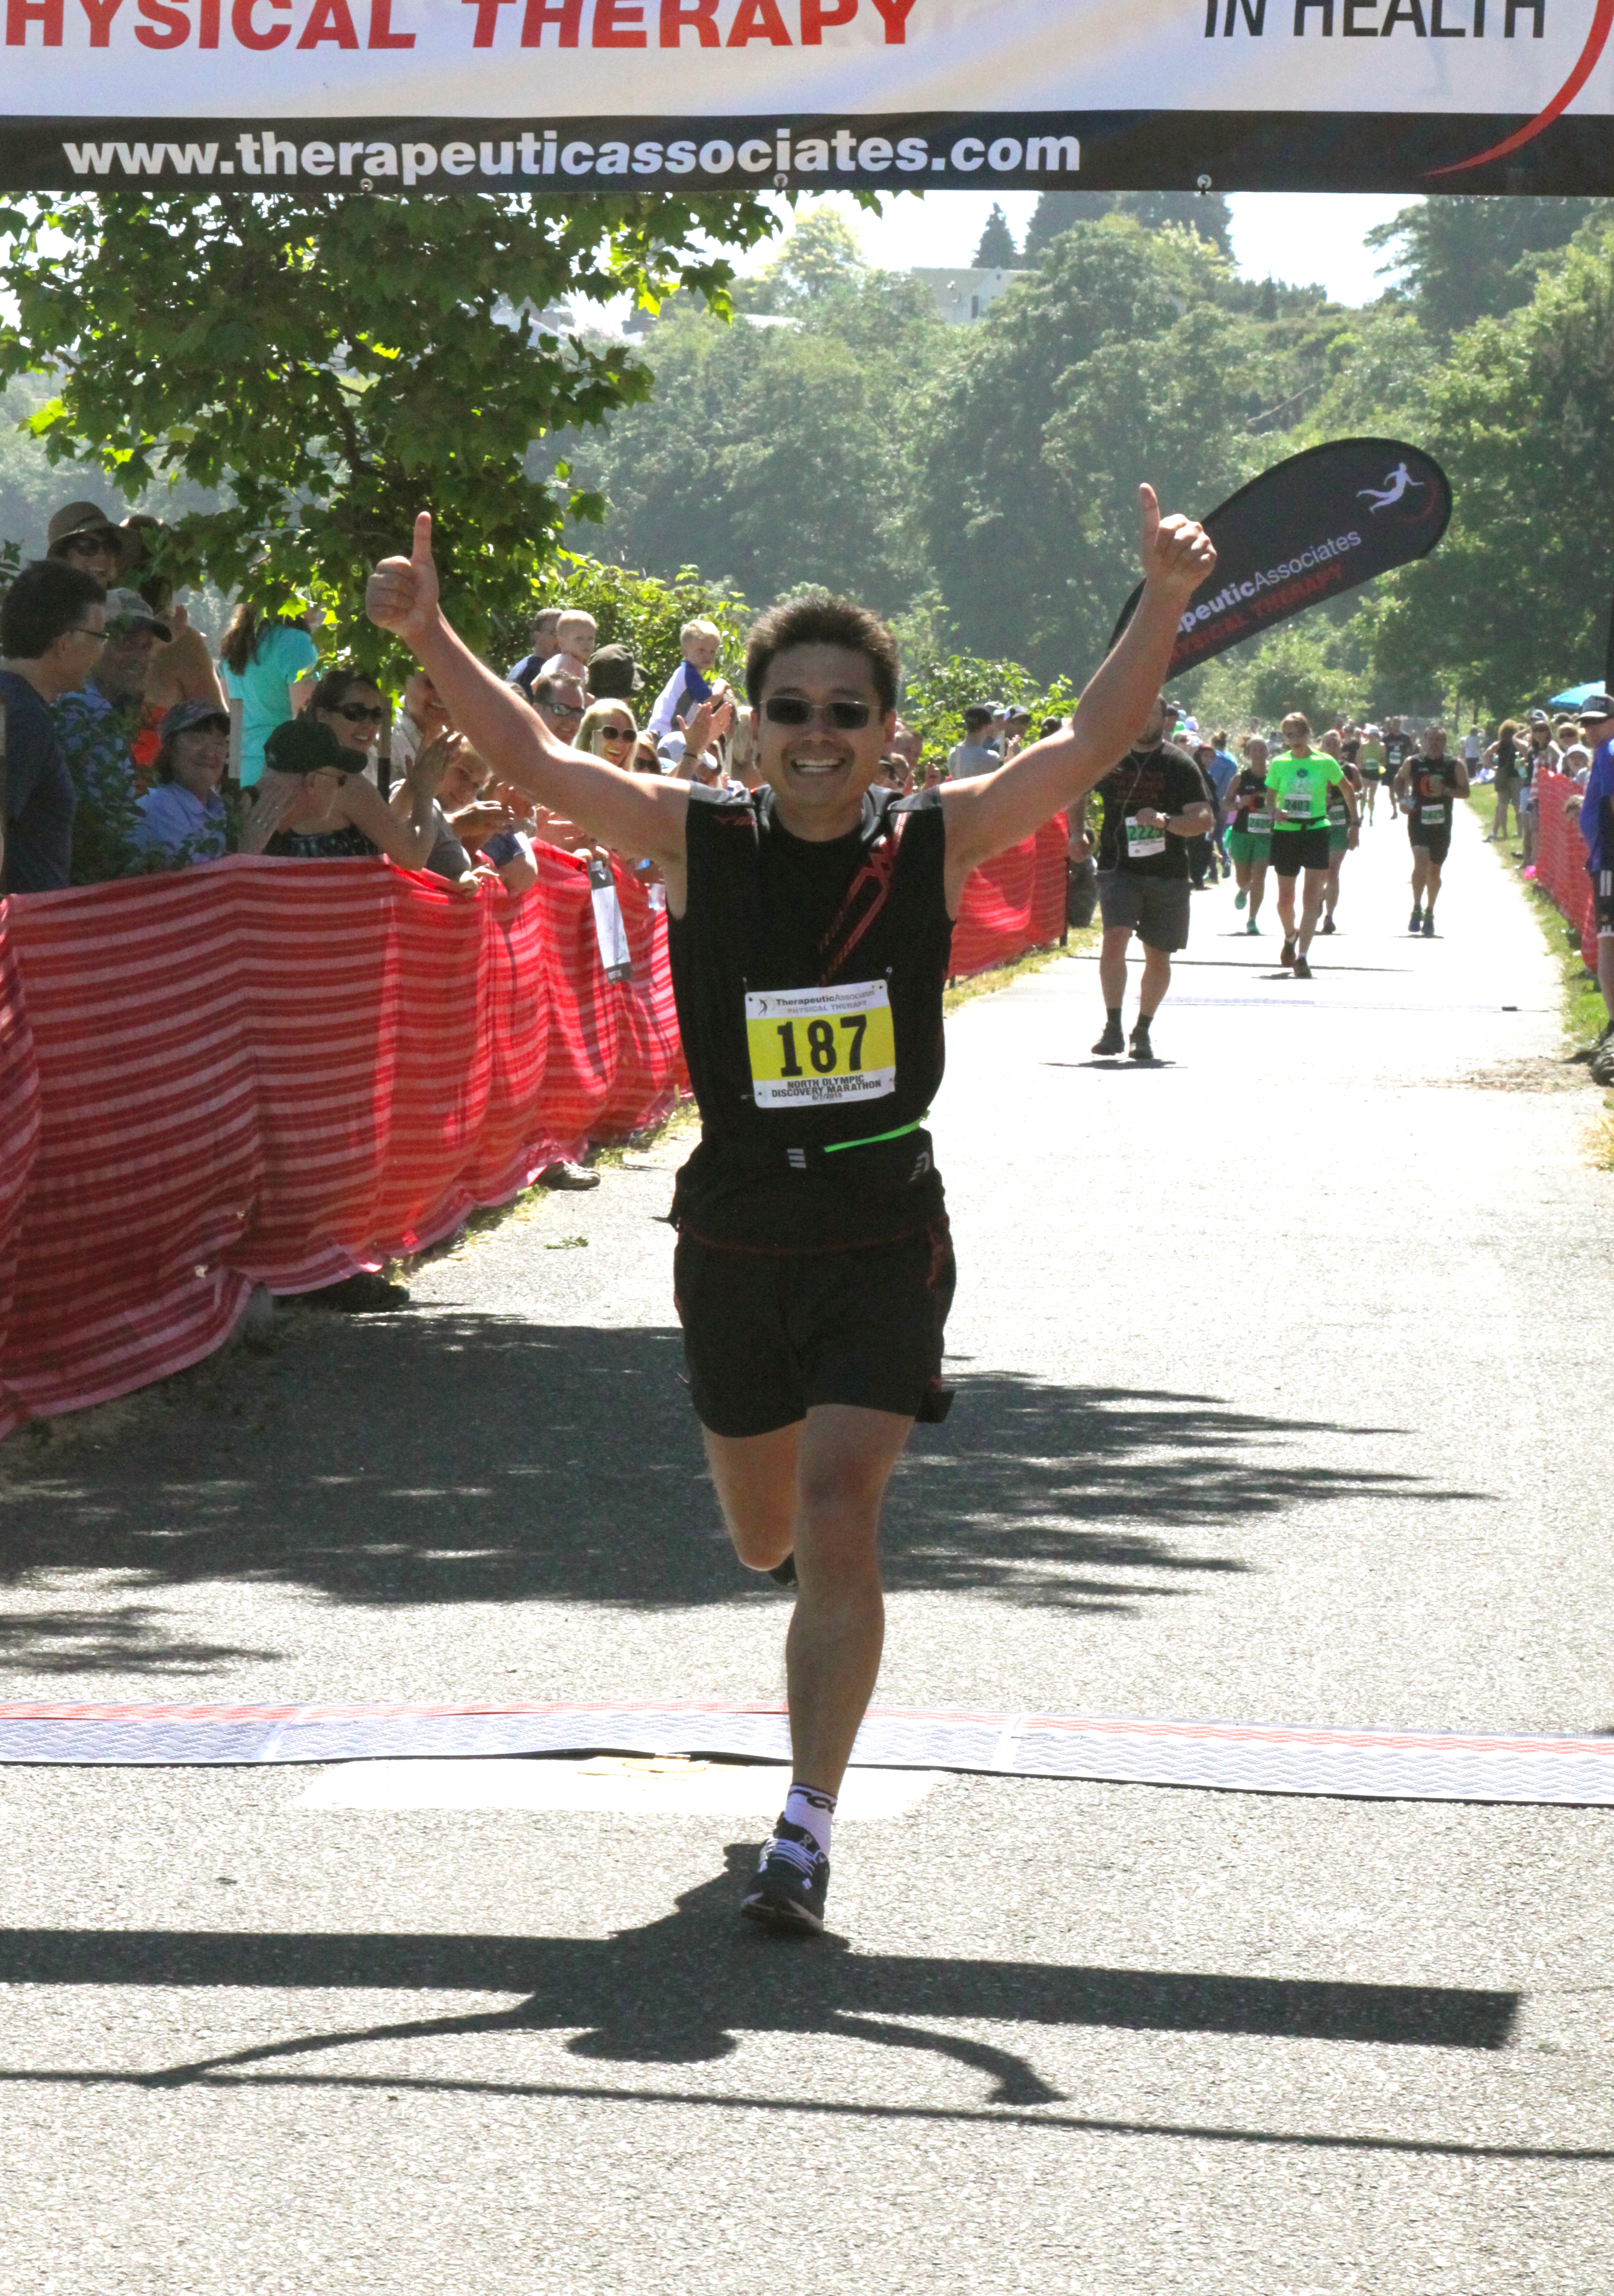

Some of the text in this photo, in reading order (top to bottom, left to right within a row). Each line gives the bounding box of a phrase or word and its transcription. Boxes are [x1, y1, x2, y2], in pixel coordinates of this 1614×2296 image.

[5, 0, 922, 50] HYSICAL THERAPY
[1204, 0, 1545, 38] IN HEALTH
[63, 127, 1081, 185] www.therapeuticassociates.com
[1176, 530, 1362, 634] peuticAssociates
[776, 990, 874, 1005] TherapeuticAssociates
[788, 1000, 867, 1014] PHYSICAL THERAPY
[777, 1014, 867, 1077] 187
[771, 1079, 882, 1097] DISCOVERY MARATHON
[787, 1075, 864, 1088] NORTH OLYMPIC
